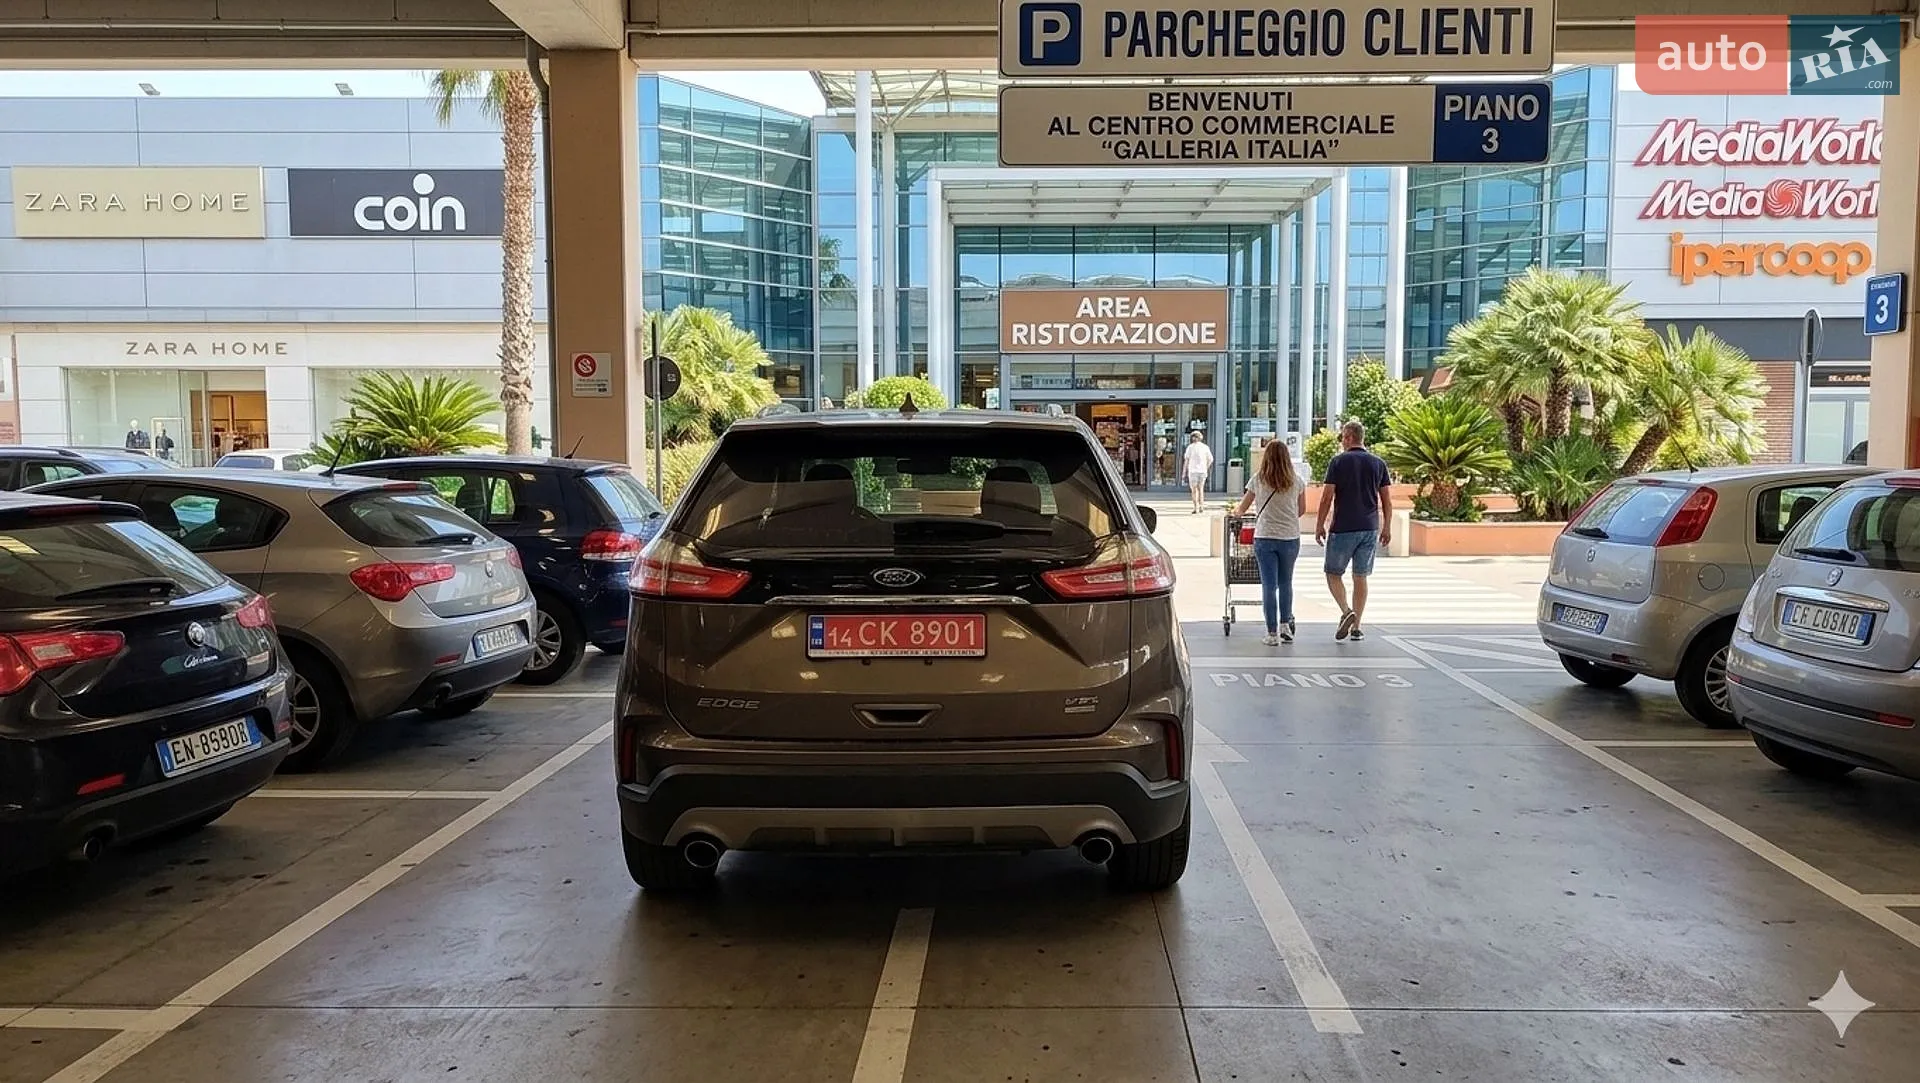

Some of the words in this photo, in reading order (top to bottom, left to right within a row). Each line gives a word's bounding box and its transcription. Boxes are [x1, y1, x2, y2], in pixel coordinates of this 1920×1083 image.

[1031, 10, 1072, 60] P
[1104, 8, 1345, 58] PARCHEGGIO
[1364, 7, 1534, 56] CLIENTI
[1148, 91, 1293, 112] BENVENUTI
[1443, 94, 1540, 122] PIANO
[1047, 116, 1081, 136] AL
[1088, 116, 1194, 136] CENTRO
[1201, 115, 1396, 136] COMMERCIALE
[1481, 127, 1500, 154] 3
[1634, 118, 1883, 166] MediaWorl
[24, 192, 126, 212] ZARA
[143, 192, 250, 212] HOME
[353, 173, 466, 232] coin
[1637, 179, 1766, 220] Media
[1799, 179, 1880, 219] Worl
[1667, 231, 1872, 286] ipercoop
[1075, 296, 1152, 319] AREA
[1874, 294, 1889, 324] 3
[1011, 322, 1218, 346] RISTORAZIONE
[126, 342, 198, 355] ZARA
[211, 342, 288, 355] HOME
[828, 627, 852, 647] 14
[858, 621, 898, 646] CK
[910, 620, 976, 646] 8901
[1208, 673, 1367, 688] PIANO
[1376, 673, 1414, 688] 3
[697, 697, 760, 709] EDGE
